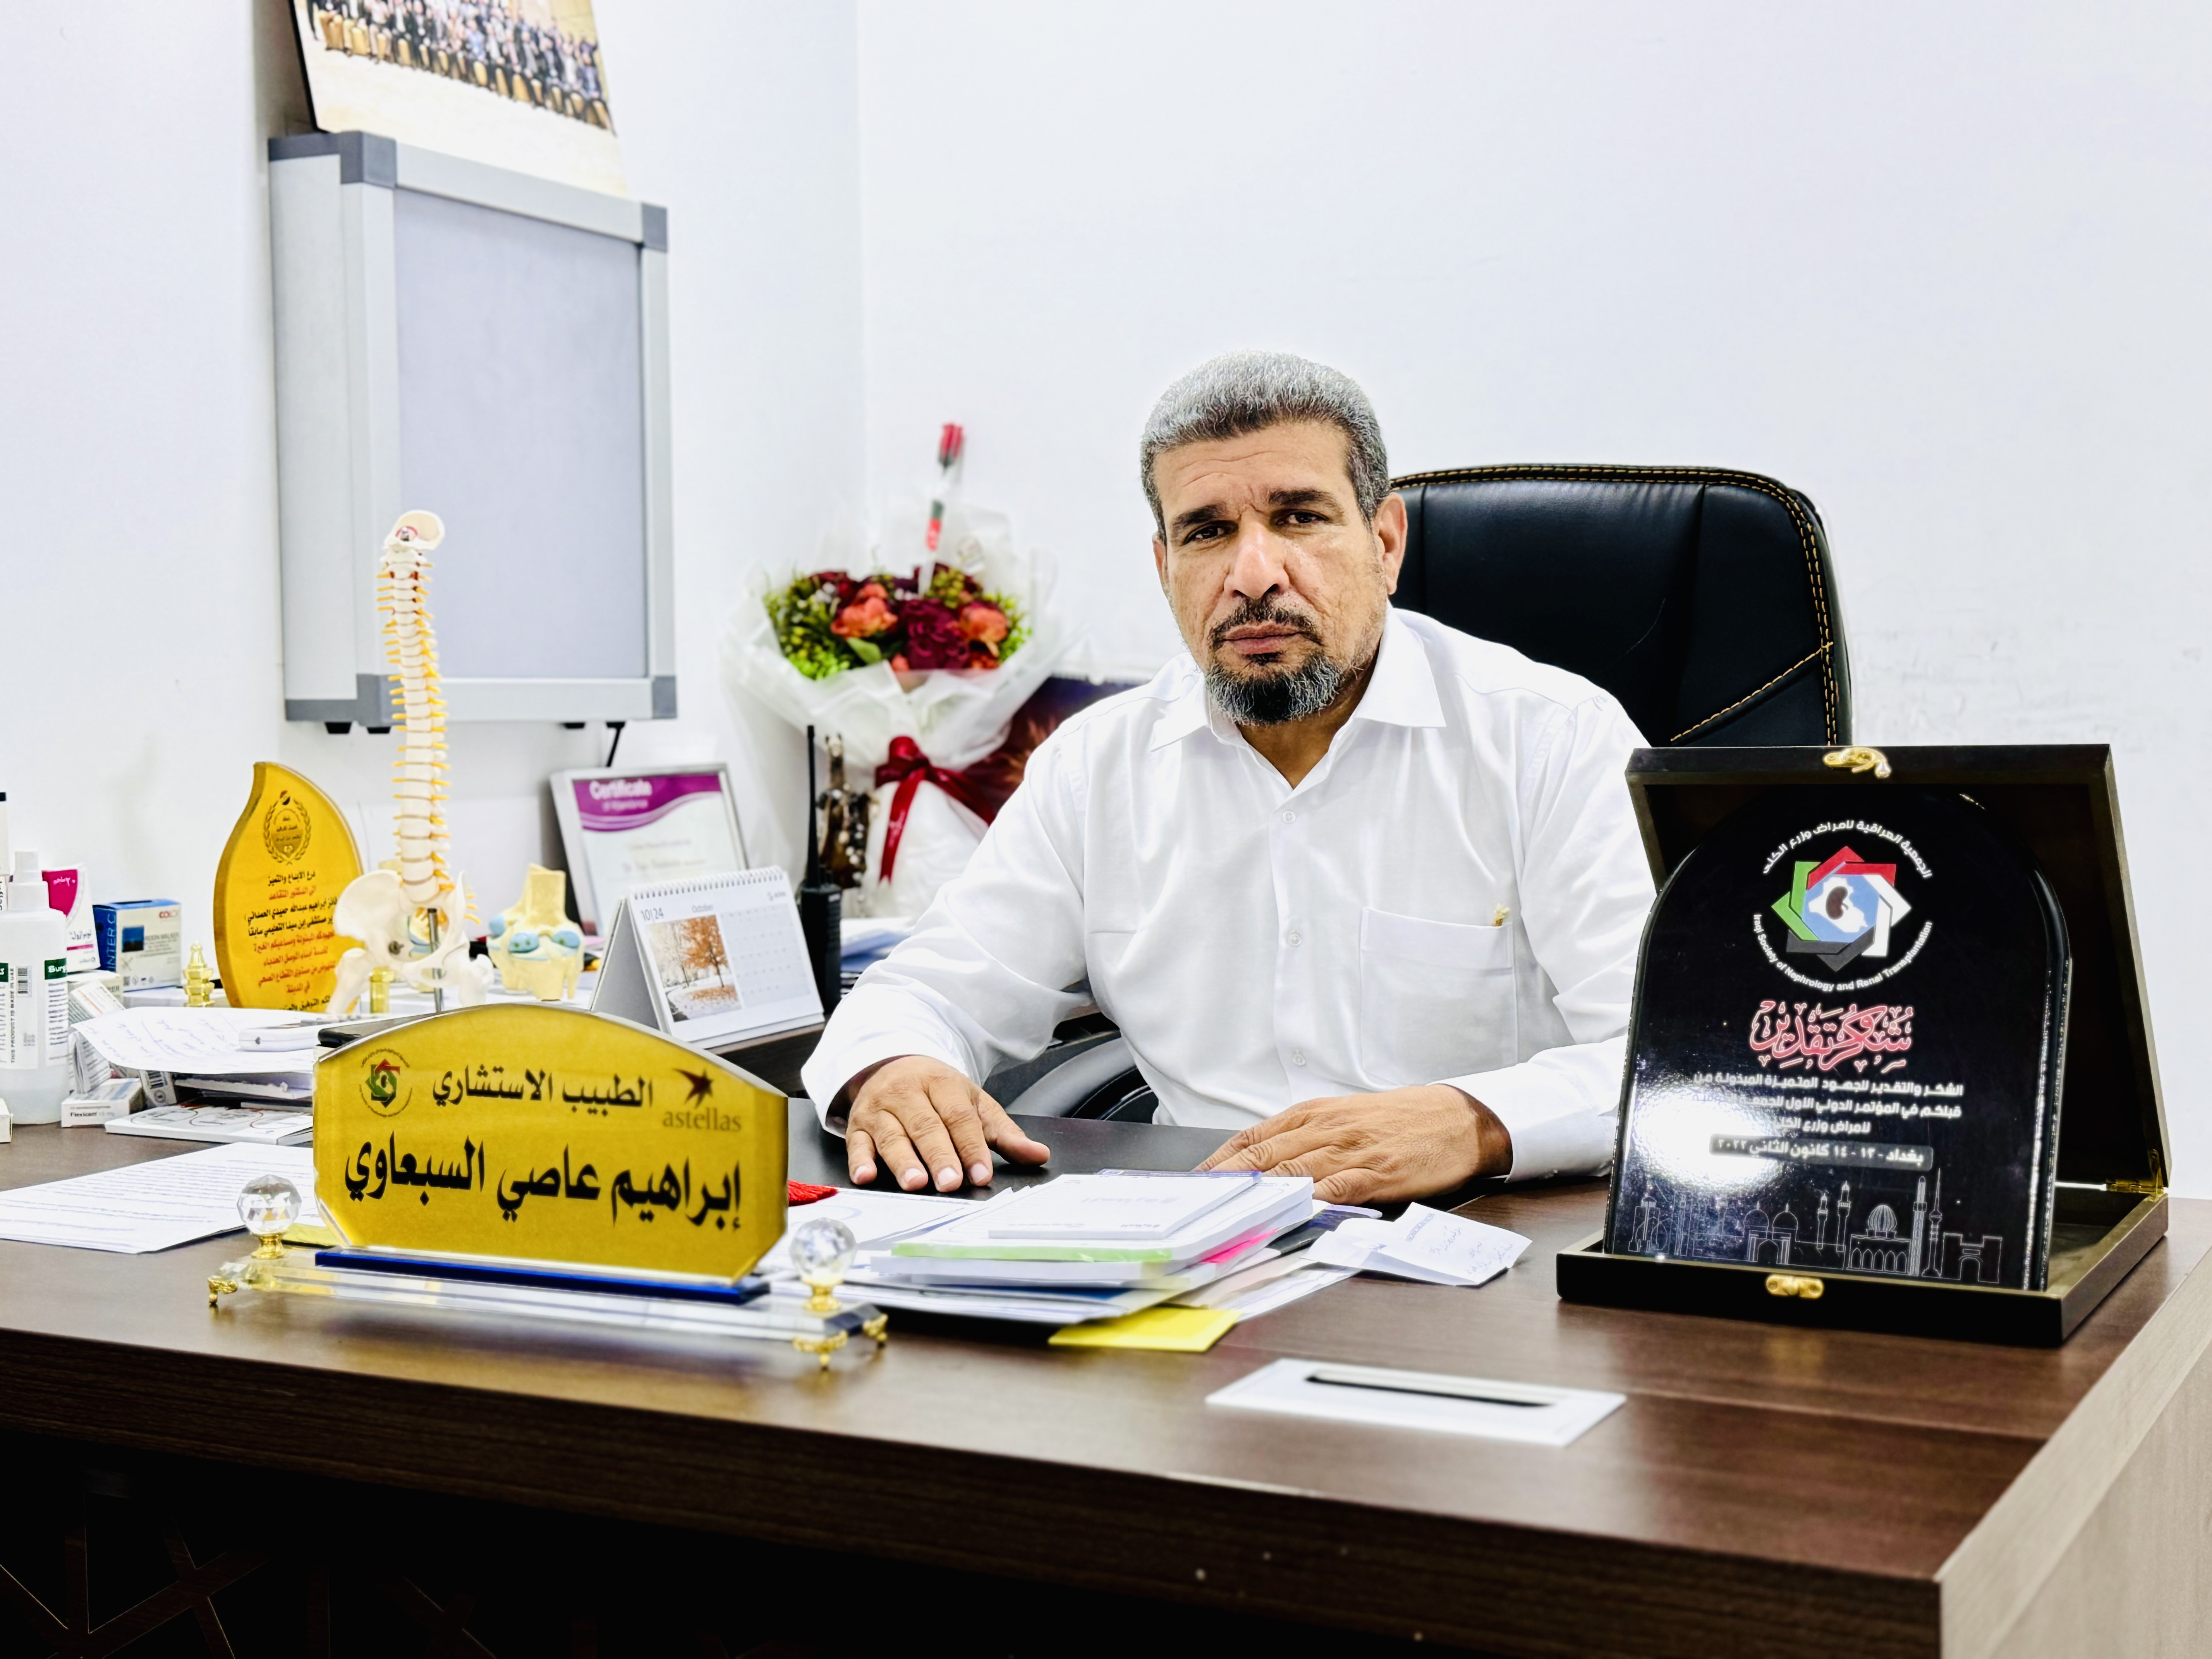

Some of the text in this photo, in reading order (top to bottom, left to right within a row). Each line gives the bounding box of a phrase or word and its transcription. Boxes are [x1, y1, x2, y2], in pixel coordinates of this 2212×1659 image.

[1856, 821, 1903, 843] العراقية
[1901, 840, 1932, 878] الجمعية
[692, 904, 713, 914] October
[1753, 914, 1932, 992] Iraqi Society of Nephrology and Renal Transplantation
[433, 1064, 553, 1108] الاستشاري
[1693, 1071, 1963, 1097] الشكر والتقدير للجهود المتميزة المبذولة من
[562, 1074, 653, 1116] الطبيب
[1815, 1099, 1853, 1114] الدولي
[1854, 1100, 1900, 1116] المؤتمر
[1901, 1104, 1918, 1119] في
[1920, 1105, 1962, 1119] قبلكم
[663, 1106, 742, 1133] astellas
[1802, 1120, 1829, 1133] وزرع
[1749, 1139, 1789, 1158] الثاني
[1790, 1143, 1829, 1159] كانون
[1834, 1145, 1847, 1158] ١٤
[1861, 1147, 1875, 1158] ١٣
[1886, 1149, 1923, 1166] بغداد
[344, 1131, 486, 1206] السبعاوي
[497, 1144, 601, 1223] عاصي
[611, 1155, 742, 1235] إبراهيم
